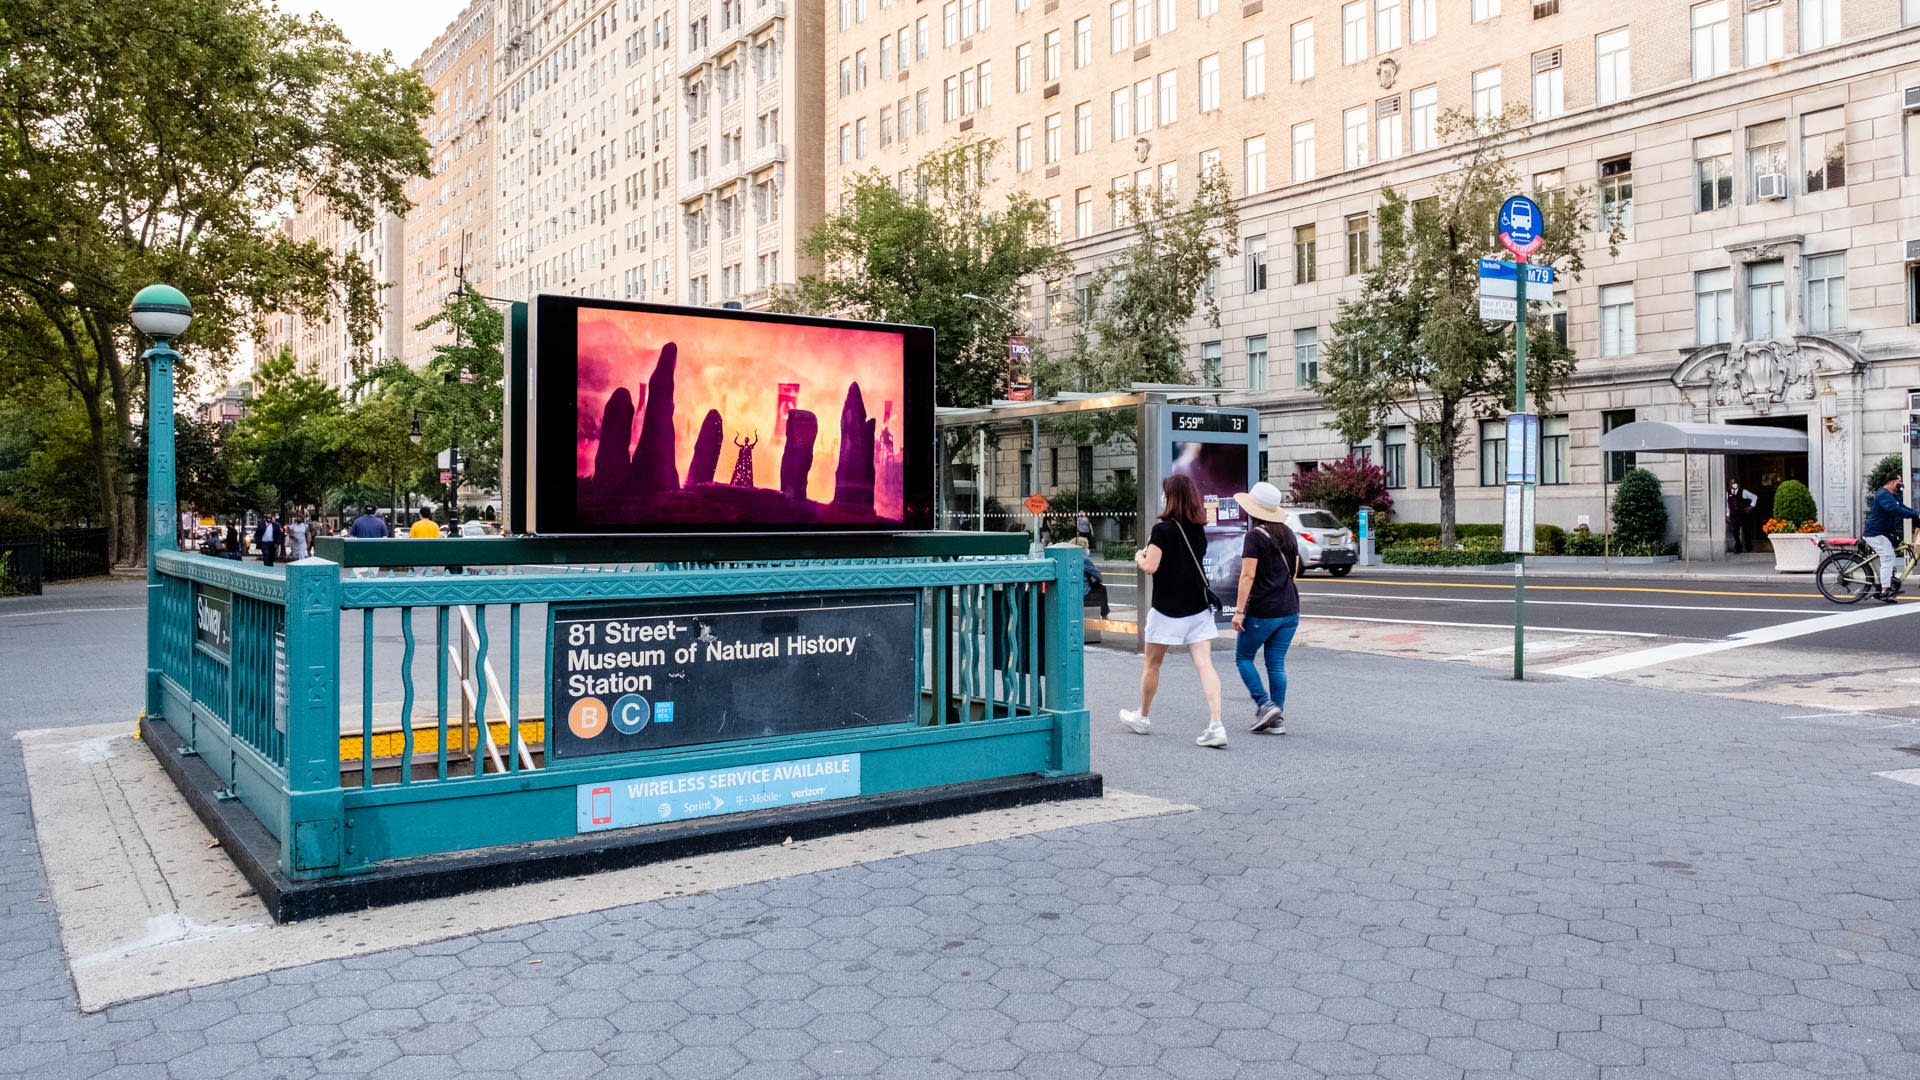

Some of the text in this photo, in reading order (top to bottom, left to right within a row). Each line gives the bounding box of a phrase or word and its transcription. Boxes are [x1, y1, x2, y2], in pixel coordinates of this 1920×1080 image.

[1527, 269, 1549, 283] M79
[197, 596, 222, 645] Subway
[568, 620, 688, 647] 81 Street-
[568, 634, 857, 672] Museum of Natural History
[568, 671, 653, 697] Station
[581, 706, 598, 729] B
[621, 702, 641, 726] C
[628, 759, 850, 800] WIRELESS SERVICE AVAILABLE
[683, 800, 711, 814] Sprint
[791, 786, 827, 799] verizon
